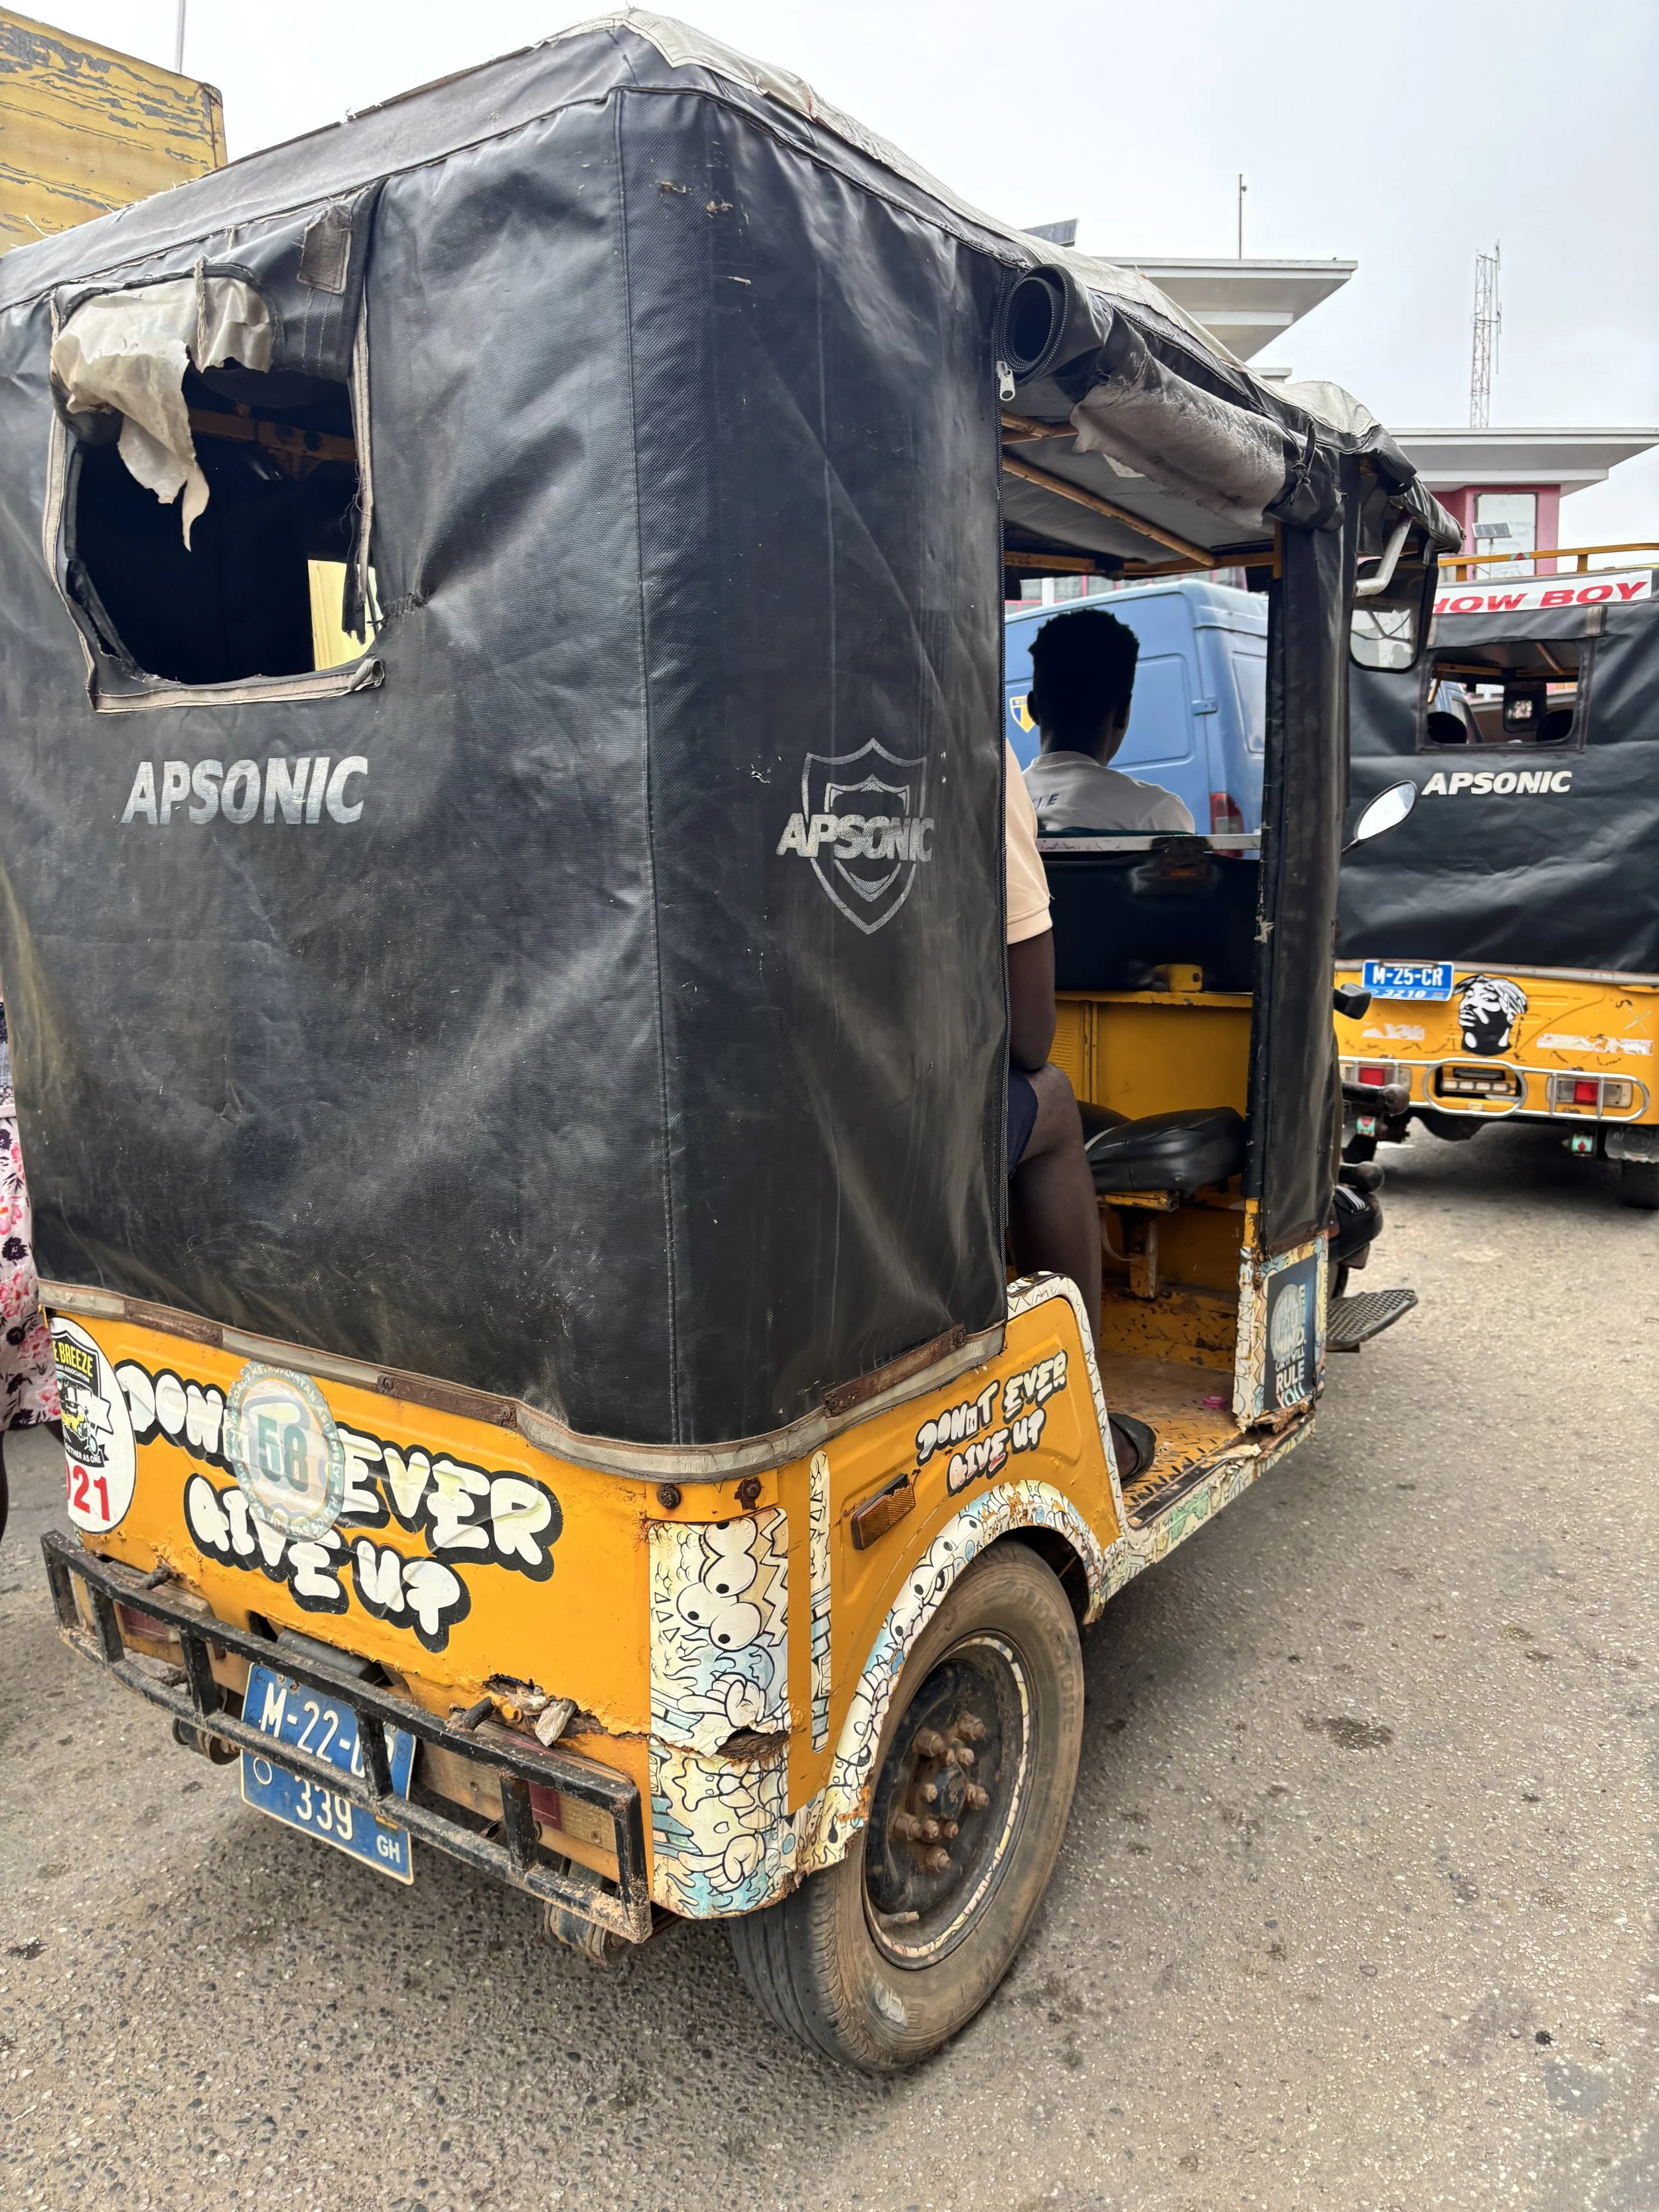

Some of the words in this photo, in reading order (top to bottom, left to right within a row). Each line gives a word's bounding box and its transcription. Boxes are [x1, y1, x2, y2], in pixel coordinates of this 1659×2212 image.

[1540, 581, 1649, 607] BOY
[121, 755, 368, 825] APSONIC
[1421, 771, 1572, 796] APSONIC
[776, 813, 934, 862] APSONIC
[1372, 965, 1443, 986] M-25-CR
[58, 1342, 94, 1377] BREEZE
[1002, 1350, 1067, 1422] EVER
[1276, 1359, 1305, 1394] RULE
[82, 1453, 90, 1463] AS
[90, 1455, 102, 1464] ONE
[257, 1414, 310, 1493] 58
[948, 1428, 1009, 1493] GIVE
[1012, 1408, 1045, 1451] UP
[66, 1461, 110, 1522] 21
[335, 1424, 558, 1576] EVER
[186, 1475, 345, 1607] GIVE
[354, 1537, 467, 1646] UP
[296, 1775, 353, 1840] 339
[376, 1834, 401, 1864] GH
